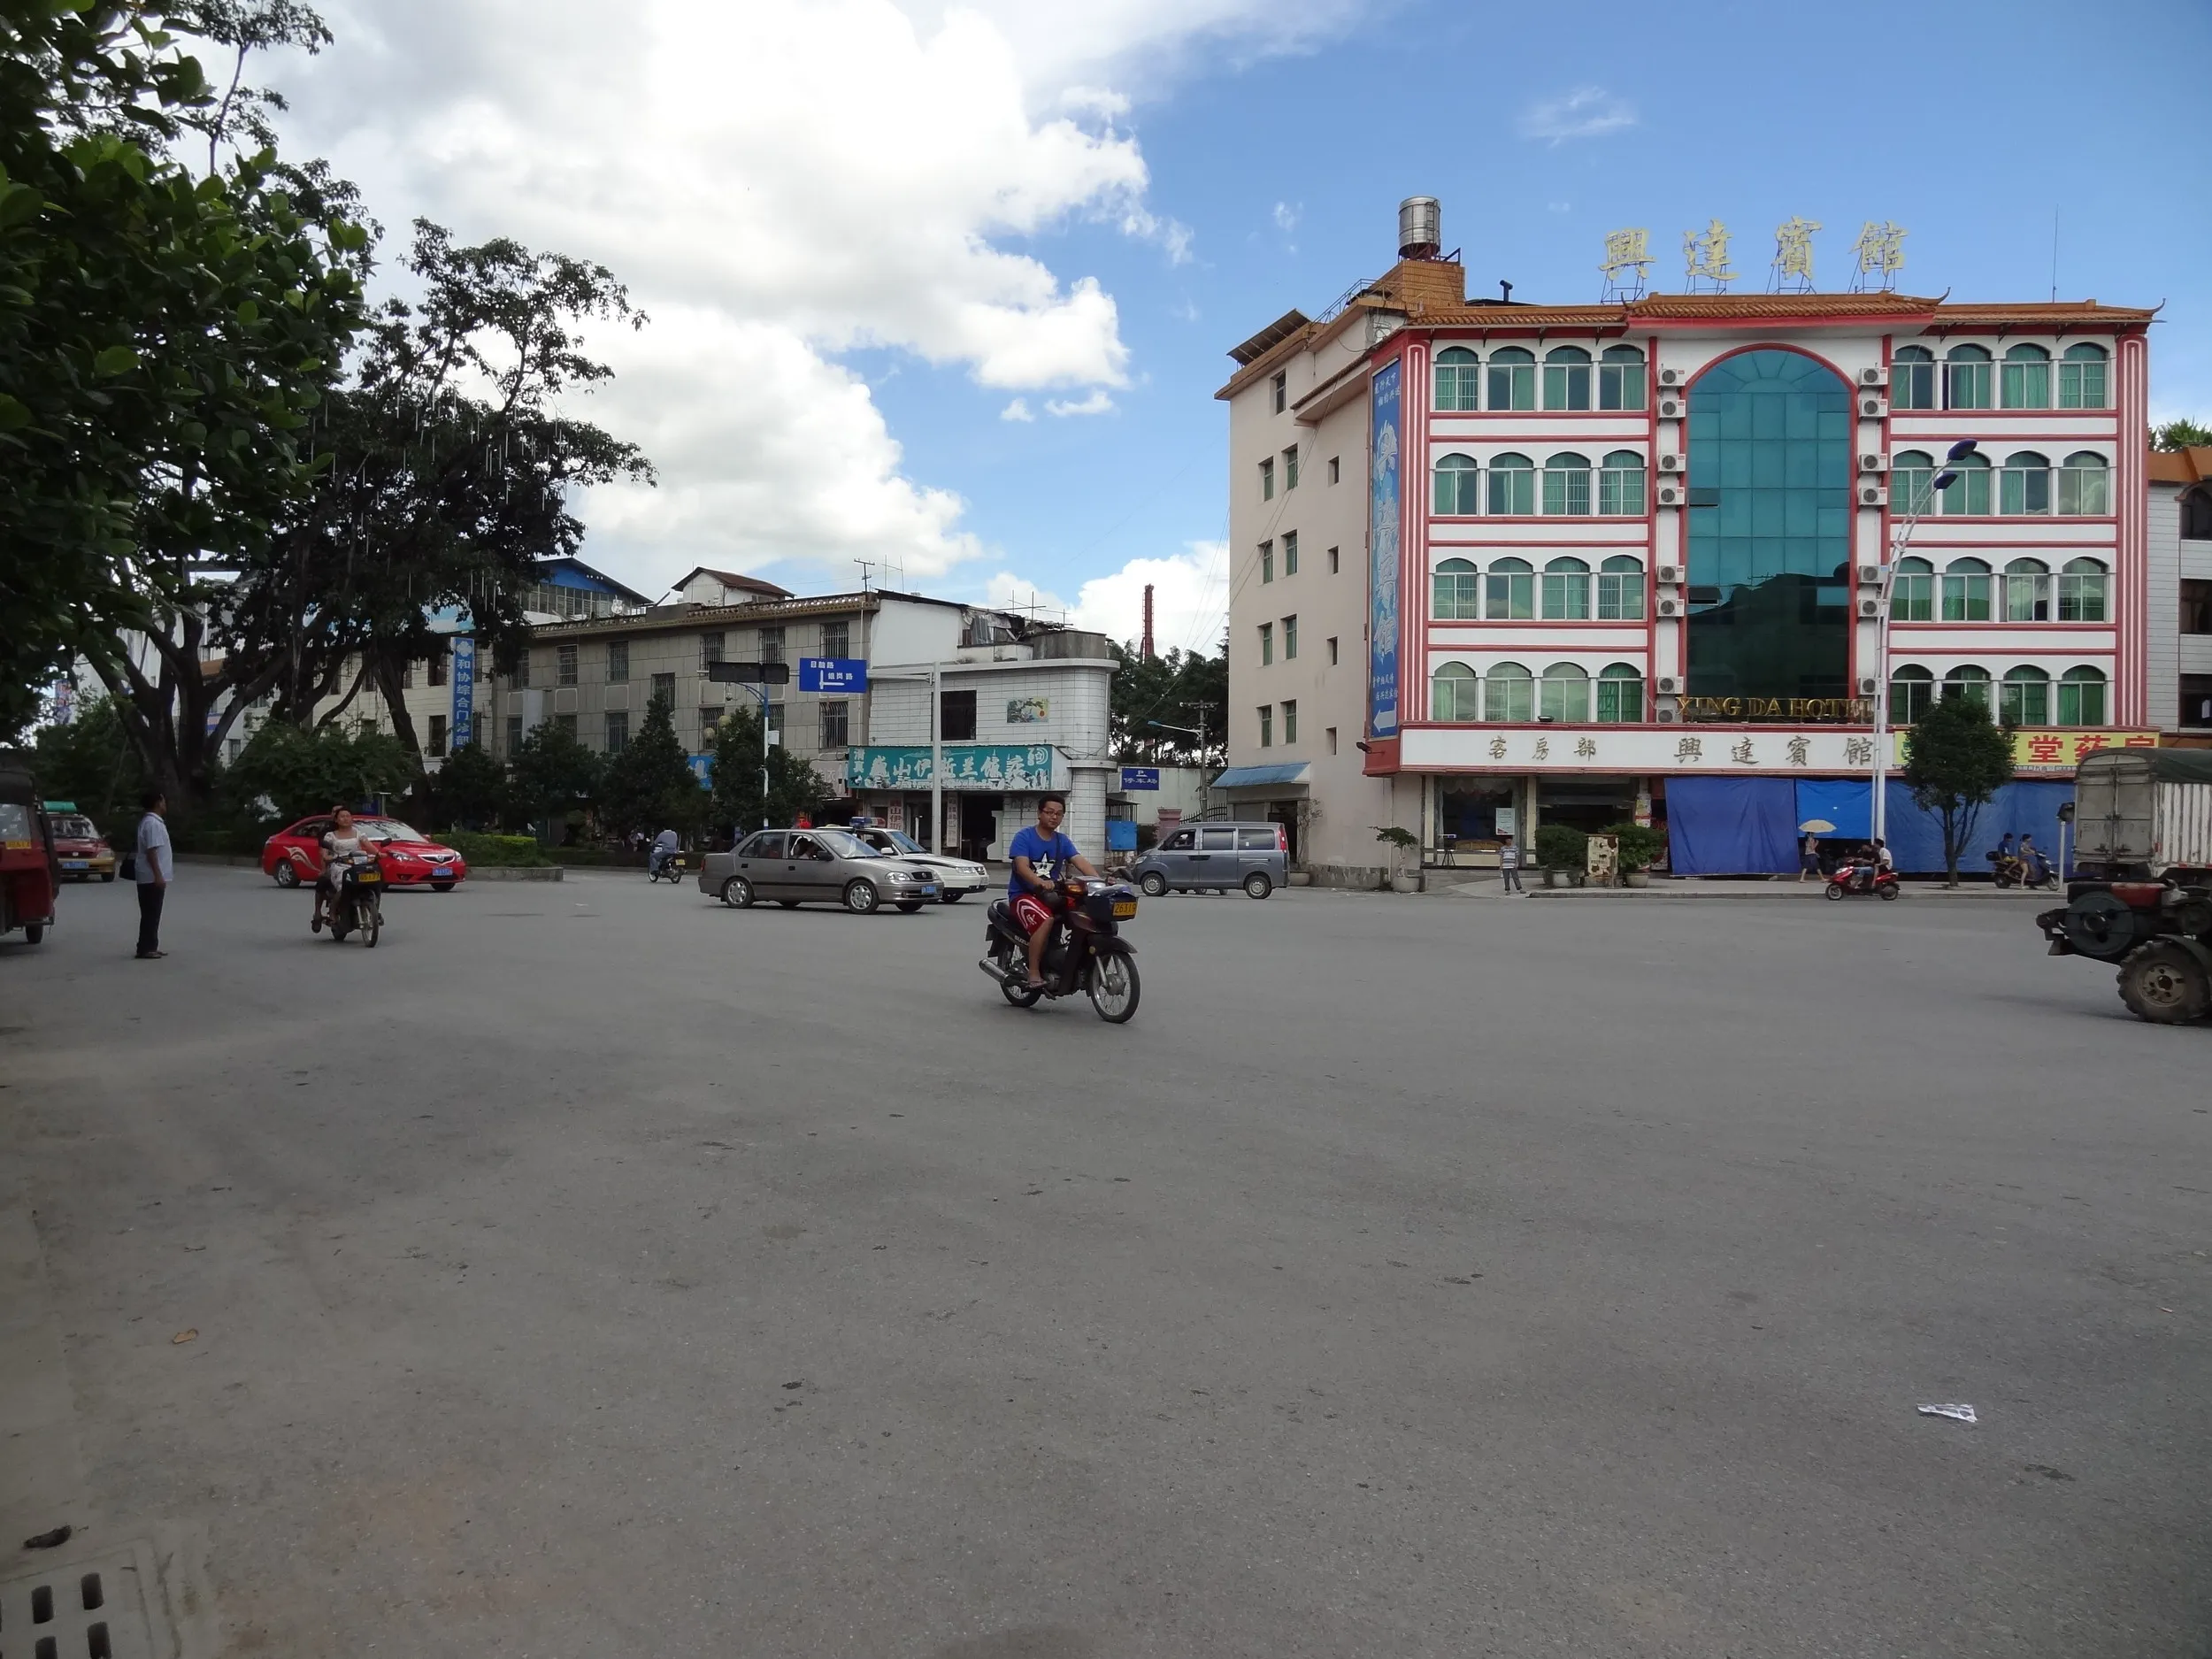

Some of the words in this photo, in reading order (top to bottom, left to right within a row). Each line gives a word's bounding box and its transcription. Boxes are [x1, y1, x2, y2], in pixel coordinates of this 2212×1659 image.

[1675, 696, 1741, 716] XING
[1747, 697, 1784, 717] DA
[1488, 735, 1597, 761] 客房部
